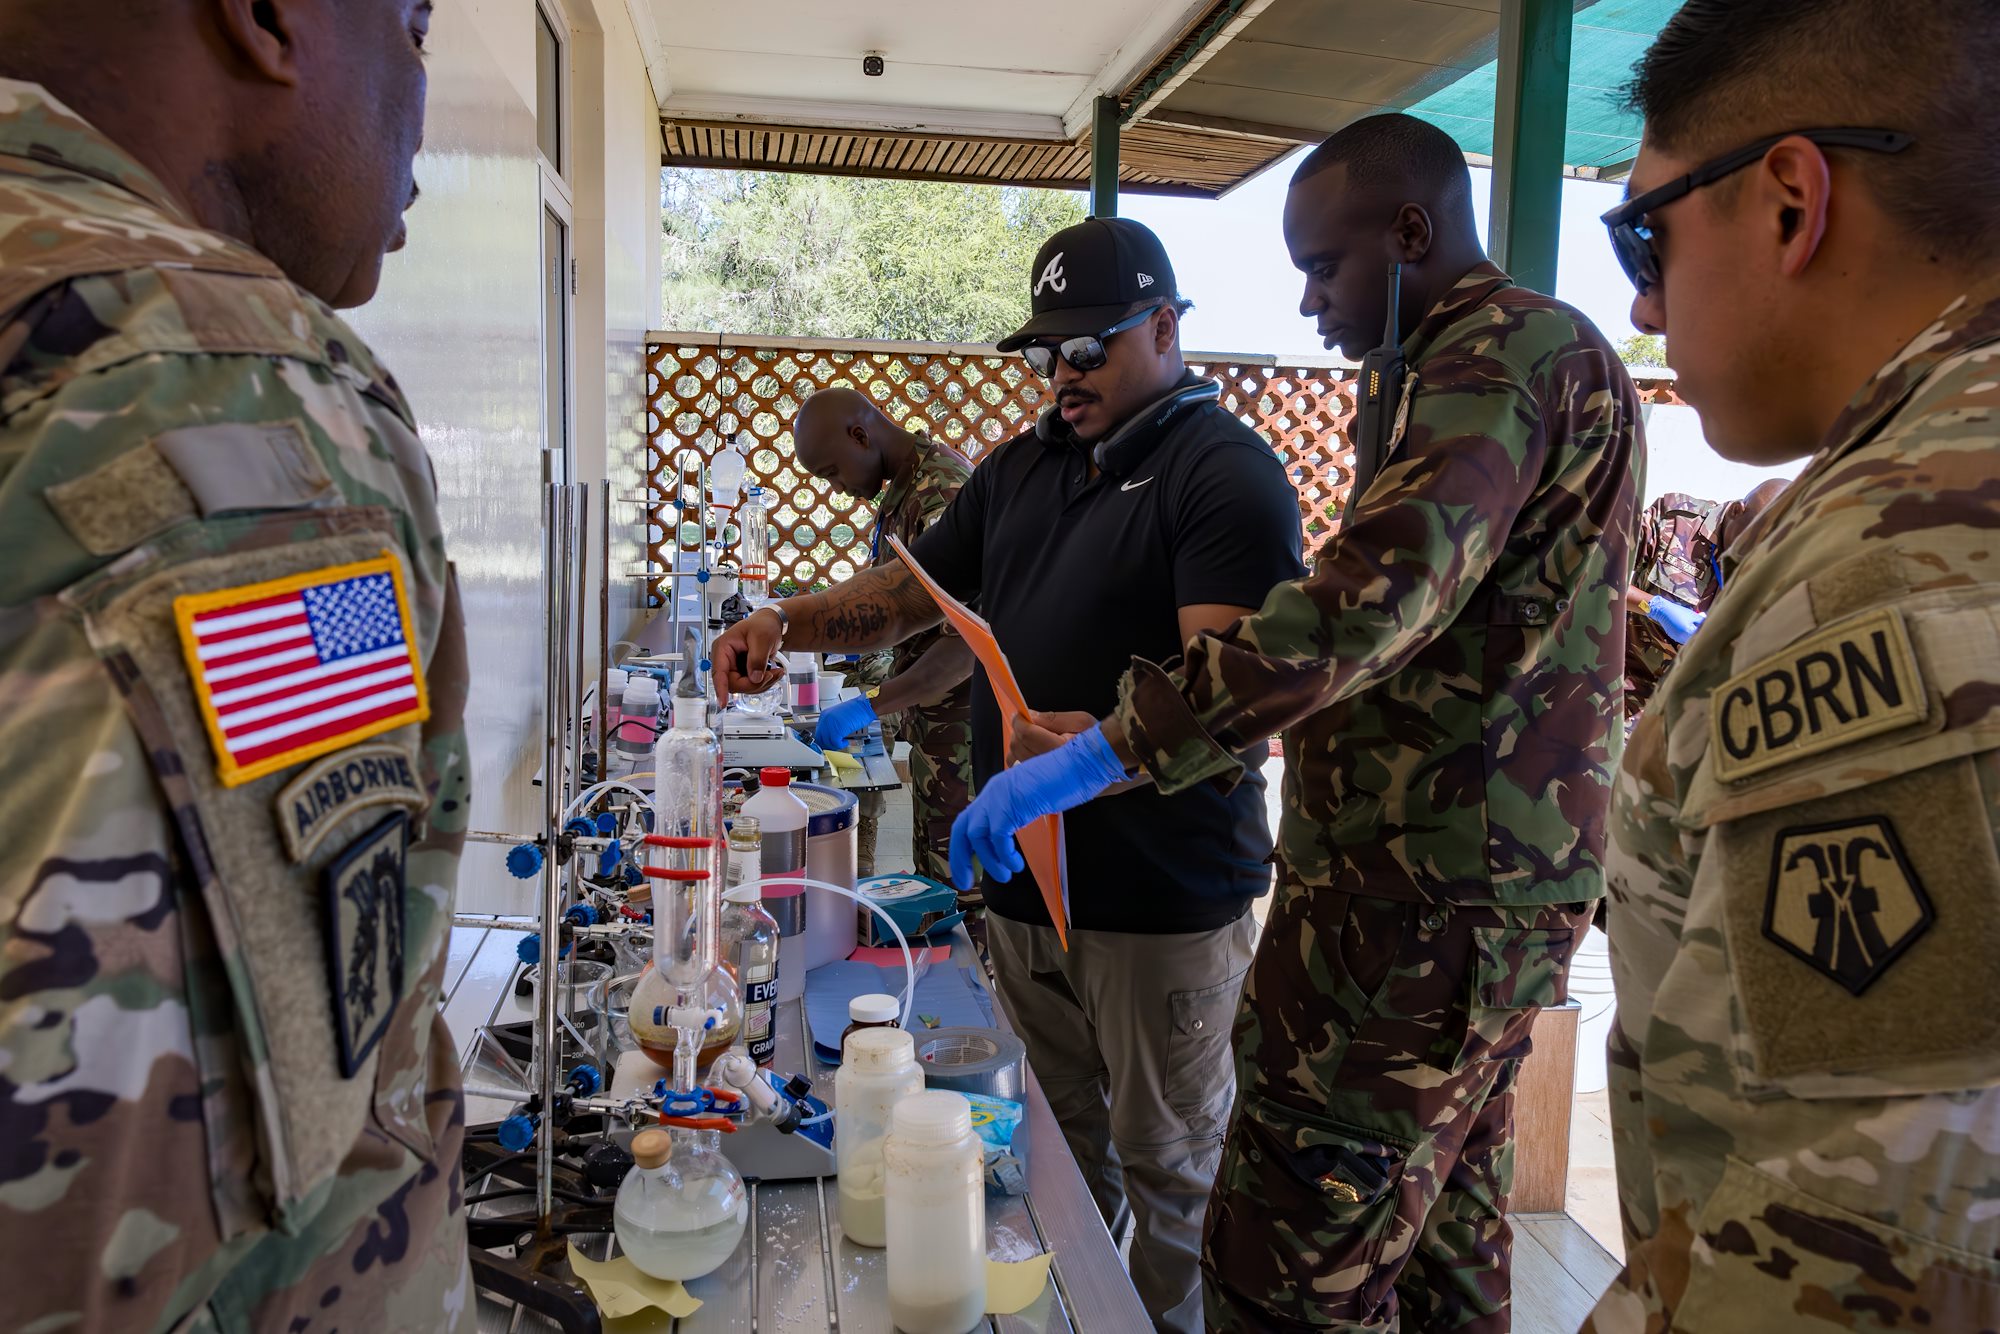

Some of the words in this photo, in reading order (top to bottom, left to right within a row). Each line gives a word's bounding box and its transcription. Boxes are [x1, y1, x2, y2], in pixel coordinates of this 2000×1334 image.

[1034, 252, 1067, 296] A
[1720, 630, 1902, 760] CBRN
[294, 756, 415, 838] AIRBORNE
[571, 1051, 584, 1059] 200
